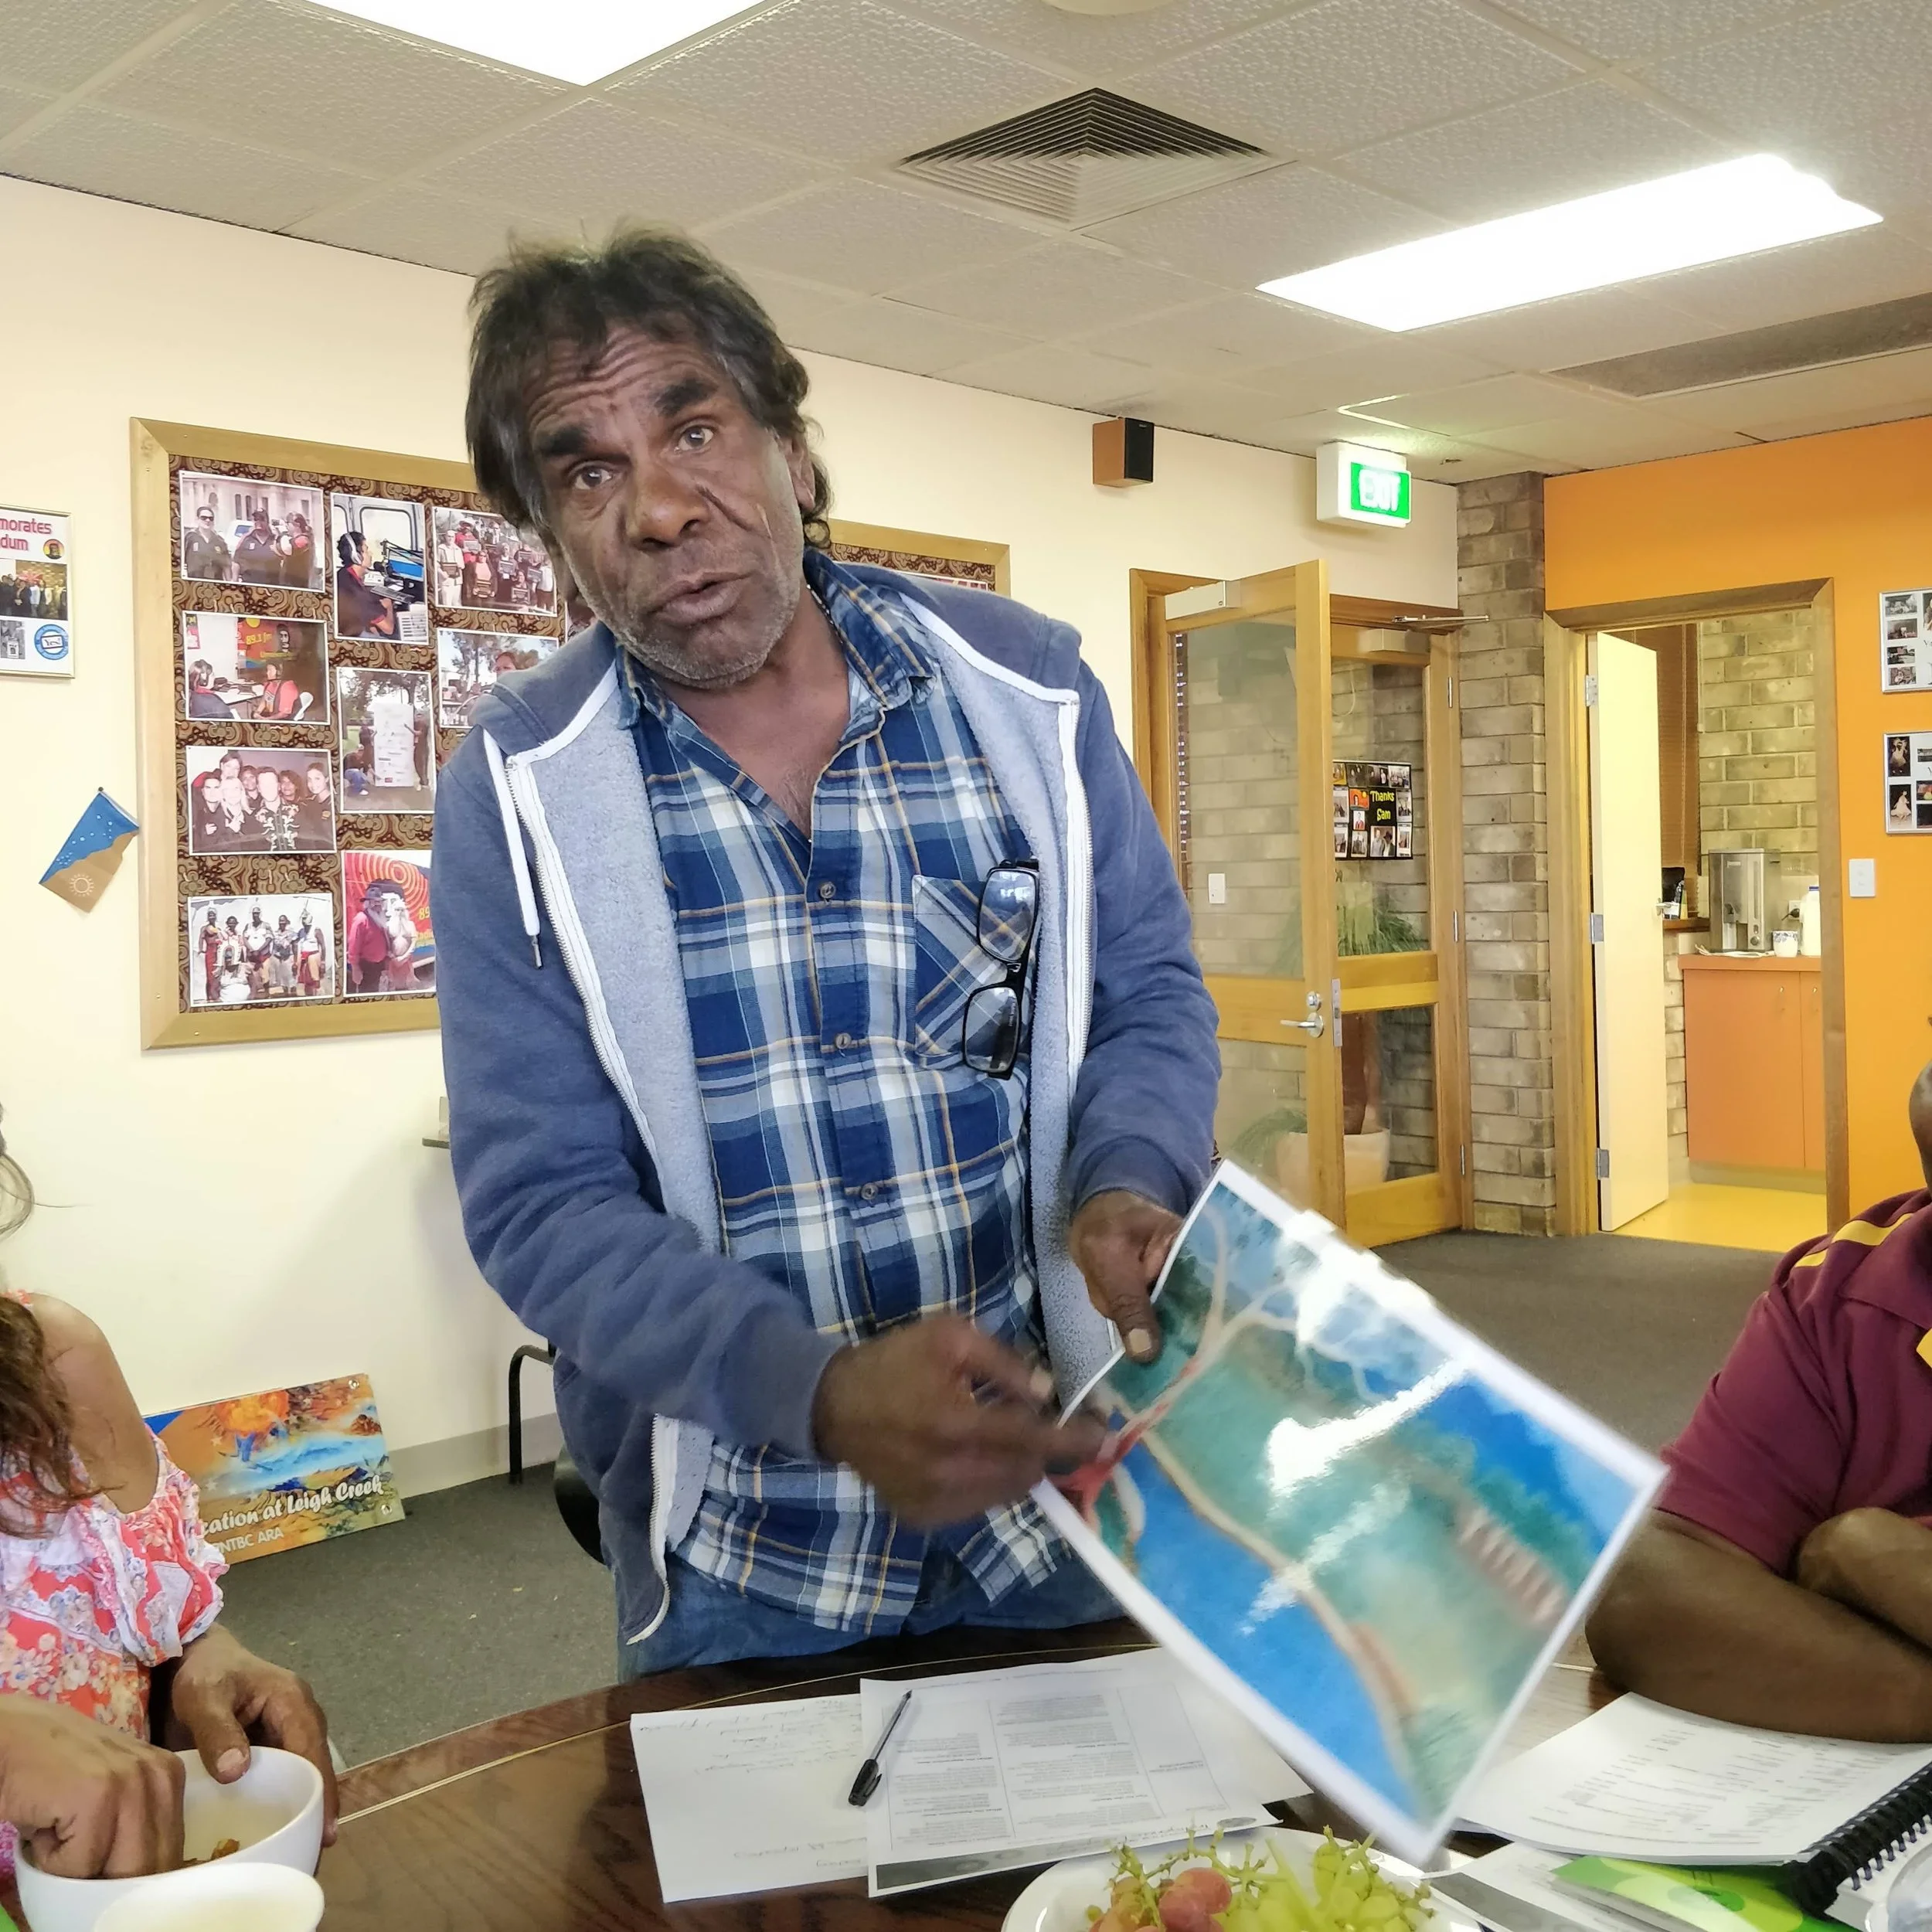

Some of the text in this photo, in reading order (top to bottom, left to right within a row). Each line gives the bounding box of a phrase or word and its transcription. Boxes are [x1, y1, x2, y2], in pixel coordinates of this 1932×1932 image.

[1359, 469, 1400, 512] EXIT
[1, 534, 29, 551] dum
[1370, 790, 1395, 802] Thanks
[1376, 808, 1391, 821] Sam
[262, 1499, 283, 1520] at
[287, 1486, 332, 1513] Leigh
[335, 1474, 384, 1502] Creek
[257, 1526, 284, 1544] ARA
